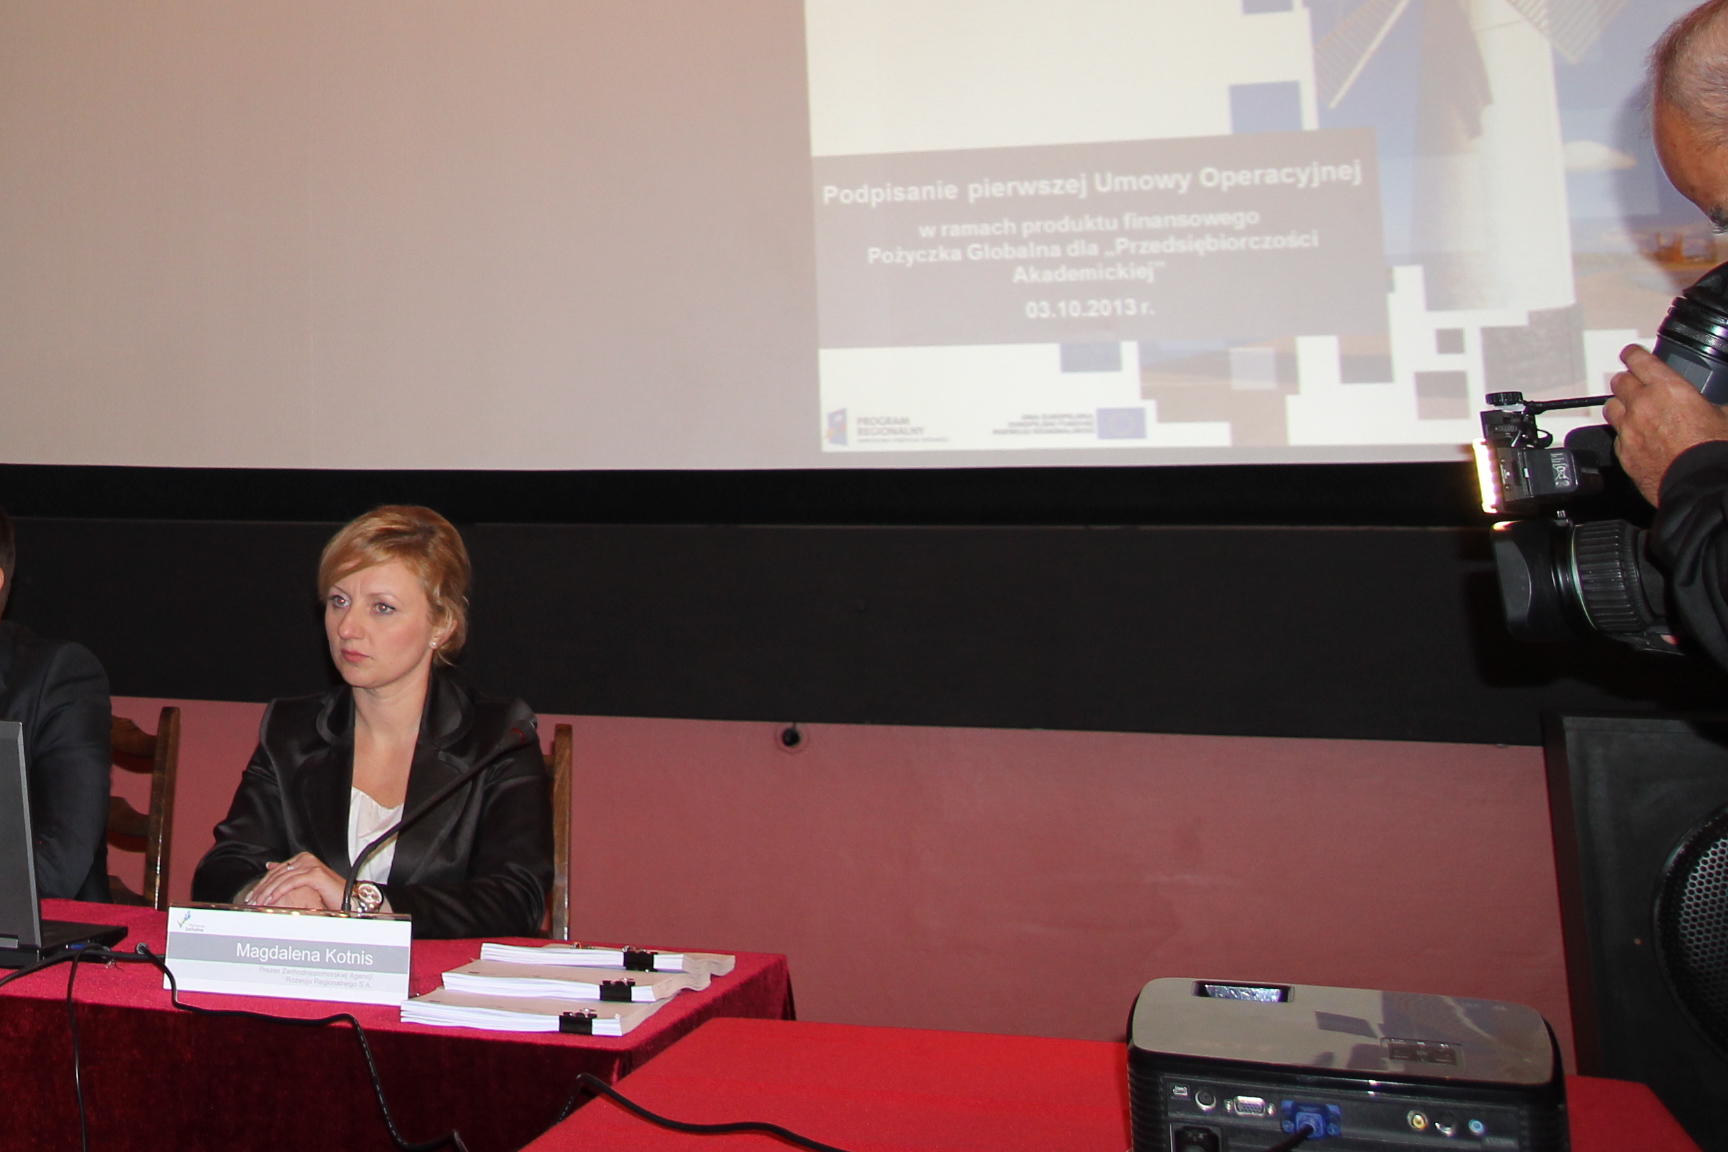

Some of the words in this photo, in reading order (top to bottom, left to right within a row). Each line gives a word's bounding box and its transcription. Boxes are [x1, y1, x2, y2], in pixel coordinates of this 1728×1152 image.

[823, 181, 958, 208] Podpisanie
[968, 174, 1087, 203] pierwszej
[1095, 172, 1191, 194] Umowy
[1200, 159, 1362, 192] Operacyjnej
[918, 223, 936, 238] w
[941, 218, 1017, 237] ramach
[1021, 212, 1118, 238] produktu
[1124, 211, 1260, 230] finansowego
[868, 245, 962, 267] Pożyczka
[967, 242, 1061, 261] Globalna
[1066, 239, 1098, 257] dla
[1025, 298, 1137, 319] 03.10.2013
[1141, 301, 1155, 315] r.
[236, 942, 321, 962] Magdalena
[325, 949, 373, 965] Kotnis
